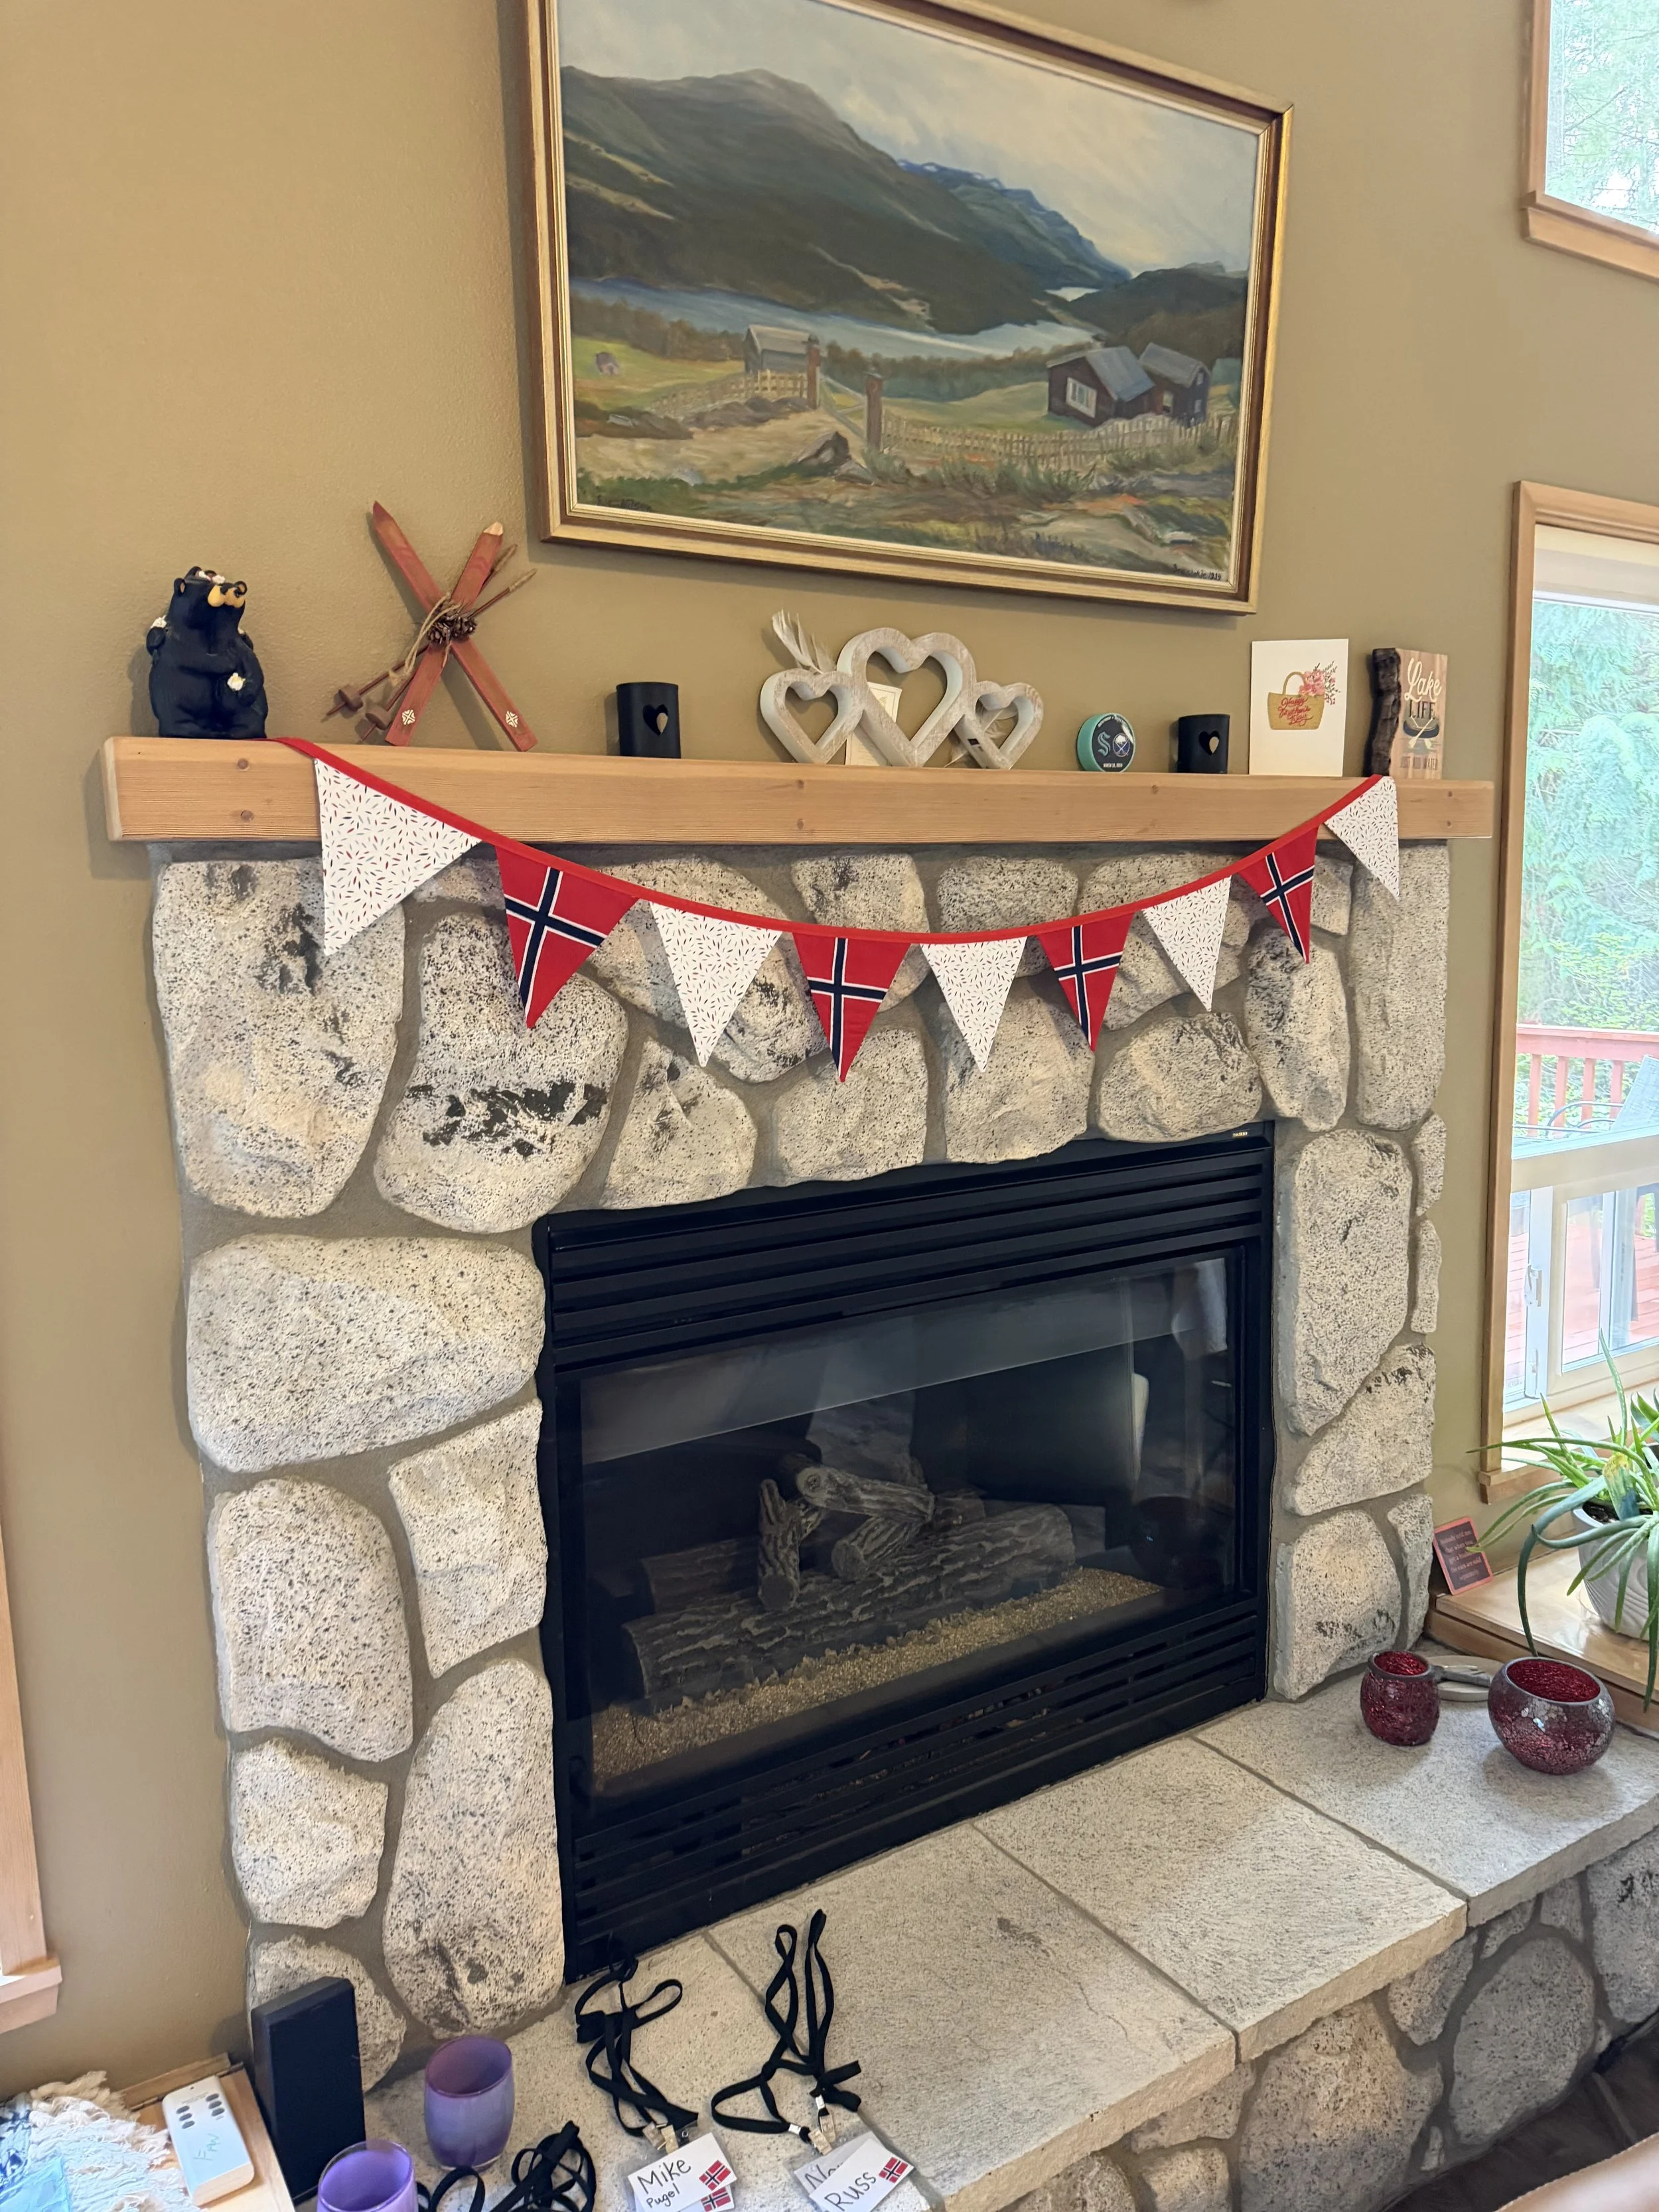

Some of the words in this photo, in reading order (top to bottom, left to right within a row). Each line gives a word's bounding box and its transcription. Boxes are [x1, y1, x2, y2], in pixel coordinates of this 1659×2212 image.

[1404, 658, 1442, 702] Lake
[1409, 700, 1435, 719] LIFE
[637, 2159, 691, 2194] Mike
